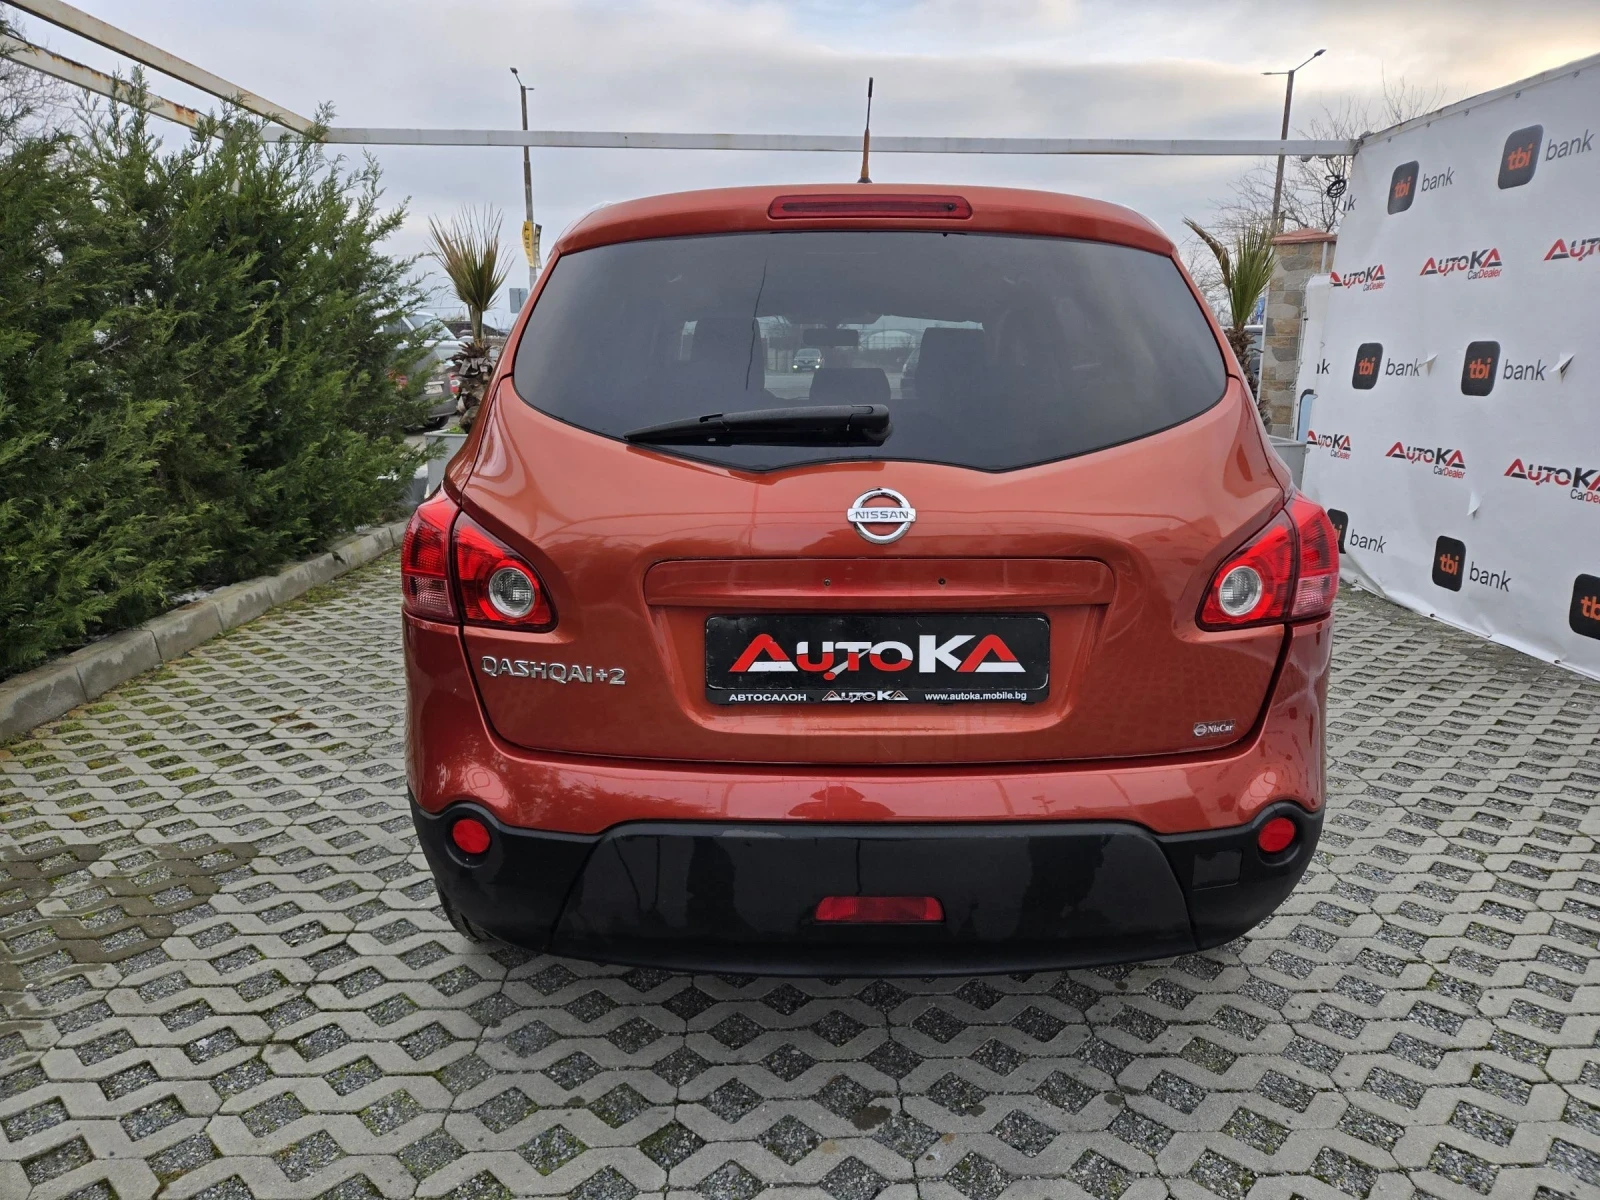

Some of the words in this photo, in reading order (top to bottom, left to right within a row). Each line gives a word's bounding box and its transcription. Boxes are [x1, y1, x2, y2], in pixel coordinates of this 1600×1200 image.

[1507, 143, 1535, 170] tbi
[1545, 129, 1594, 161] bank
[1394, 176, 1412, 199] tbi
[1420, 166, 1455, 192] bank
[1543, 238, 1600, 261] AUT
[1467, 268, 1502, 280] CarDealer
[1358, 356, 1376, 375] tbi
[1385, 358, 1421, 376] bank
[1468, 357, 1492, 378] tbi
[1503, 359, 1546, 380] bank
[1433, 465, 1466, 479] CarDealer
[855, 511, 909, 519] NISSAN
[1350, 528, 1387, 554] bank
[1439, 553, 1460, 576] tbi
[1469, 561, 1512, 592] bank
[481, 655, 626, 685] QASHQAI+2
[729, 693, 807, 702] АВТОСАЛОН
[924, 691, 1027, 701] www.autoka.mobile.bg
